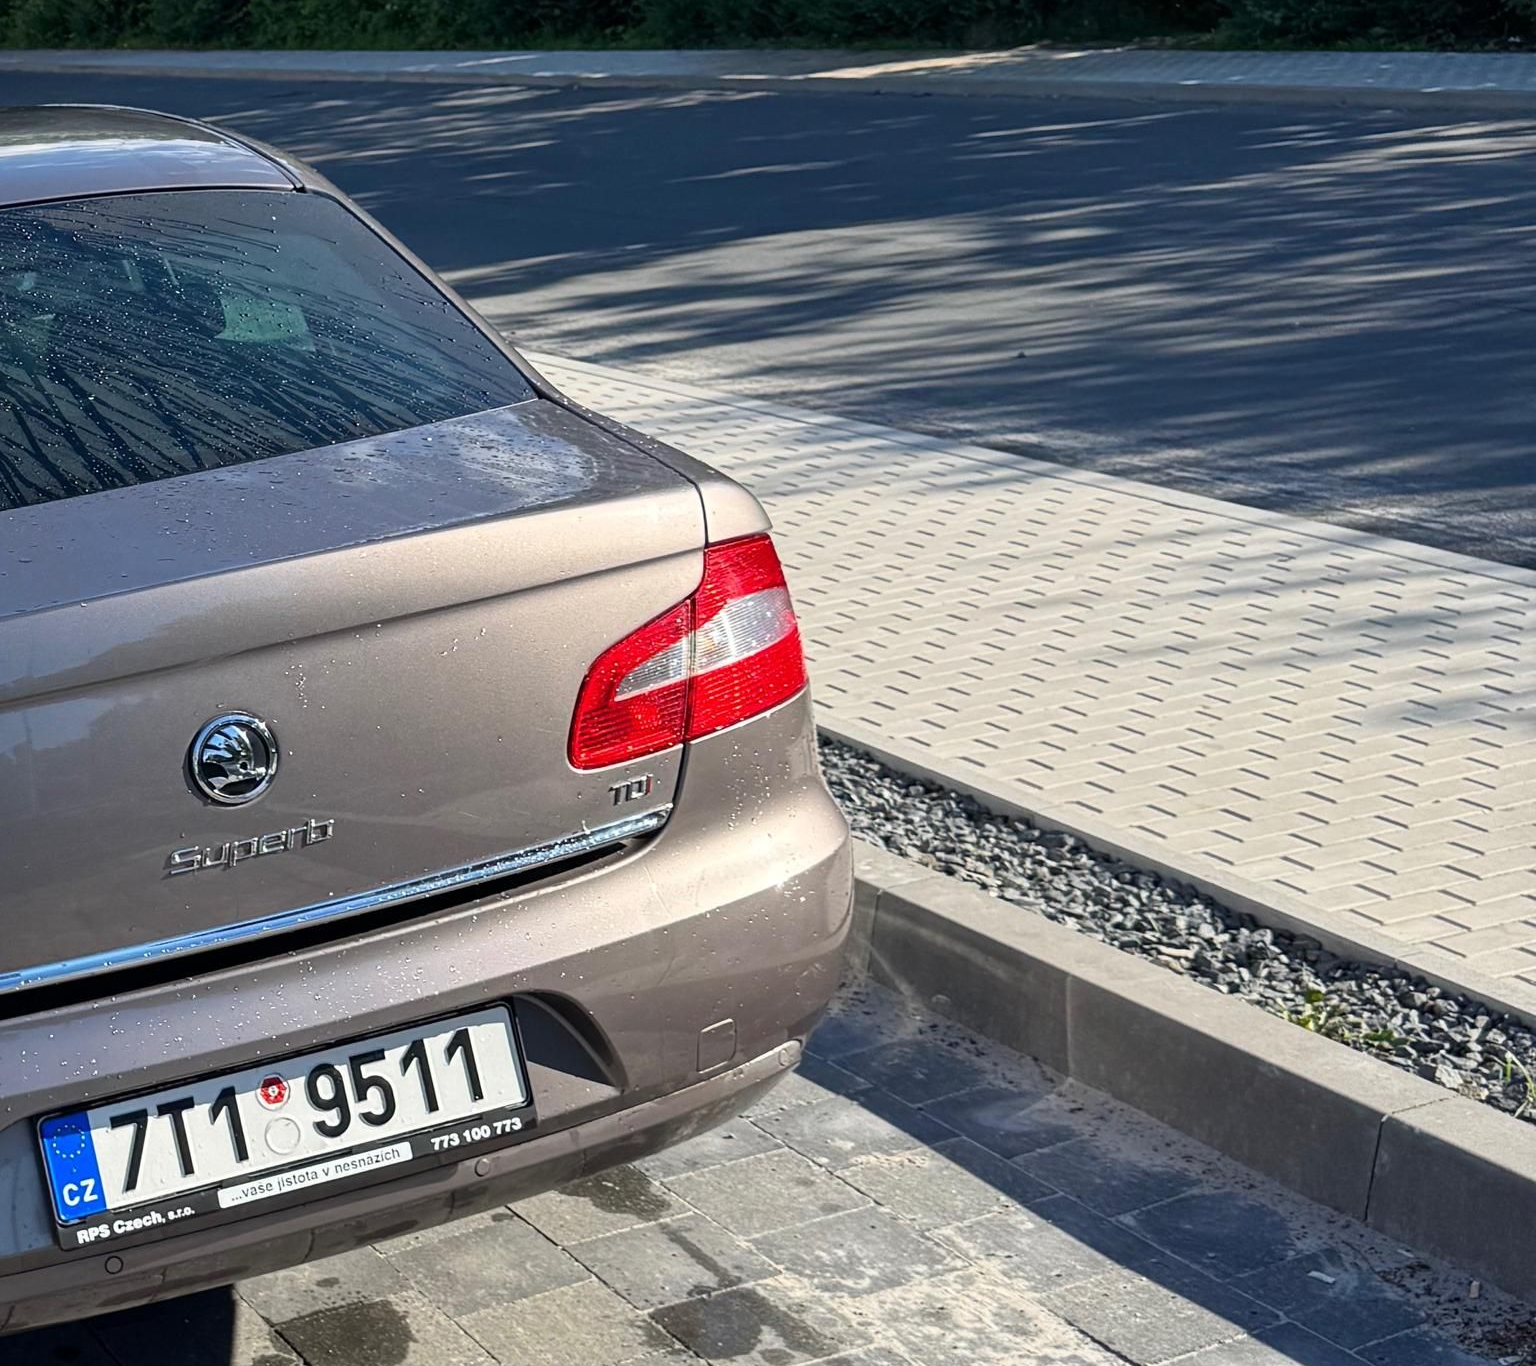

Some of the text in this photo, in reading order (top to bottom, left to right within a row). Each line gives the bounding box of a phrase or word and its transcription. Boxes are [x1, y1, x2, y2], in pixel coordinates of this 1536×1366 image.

[608, 773, 654, 806] TDI
[170, 818, 335, 875] Superb
[109, 1027, 484, 1194] 7T1 9511
[430, 1116, 523, 1151] 773 100 773
[63, 1178, 99, 1207] CZ
[277, 1169, 319, 1192] jistota
[322, 1167, 330, 1177] v
[77, 1206, 196, 1245] RPS Czech, s.r.o.
